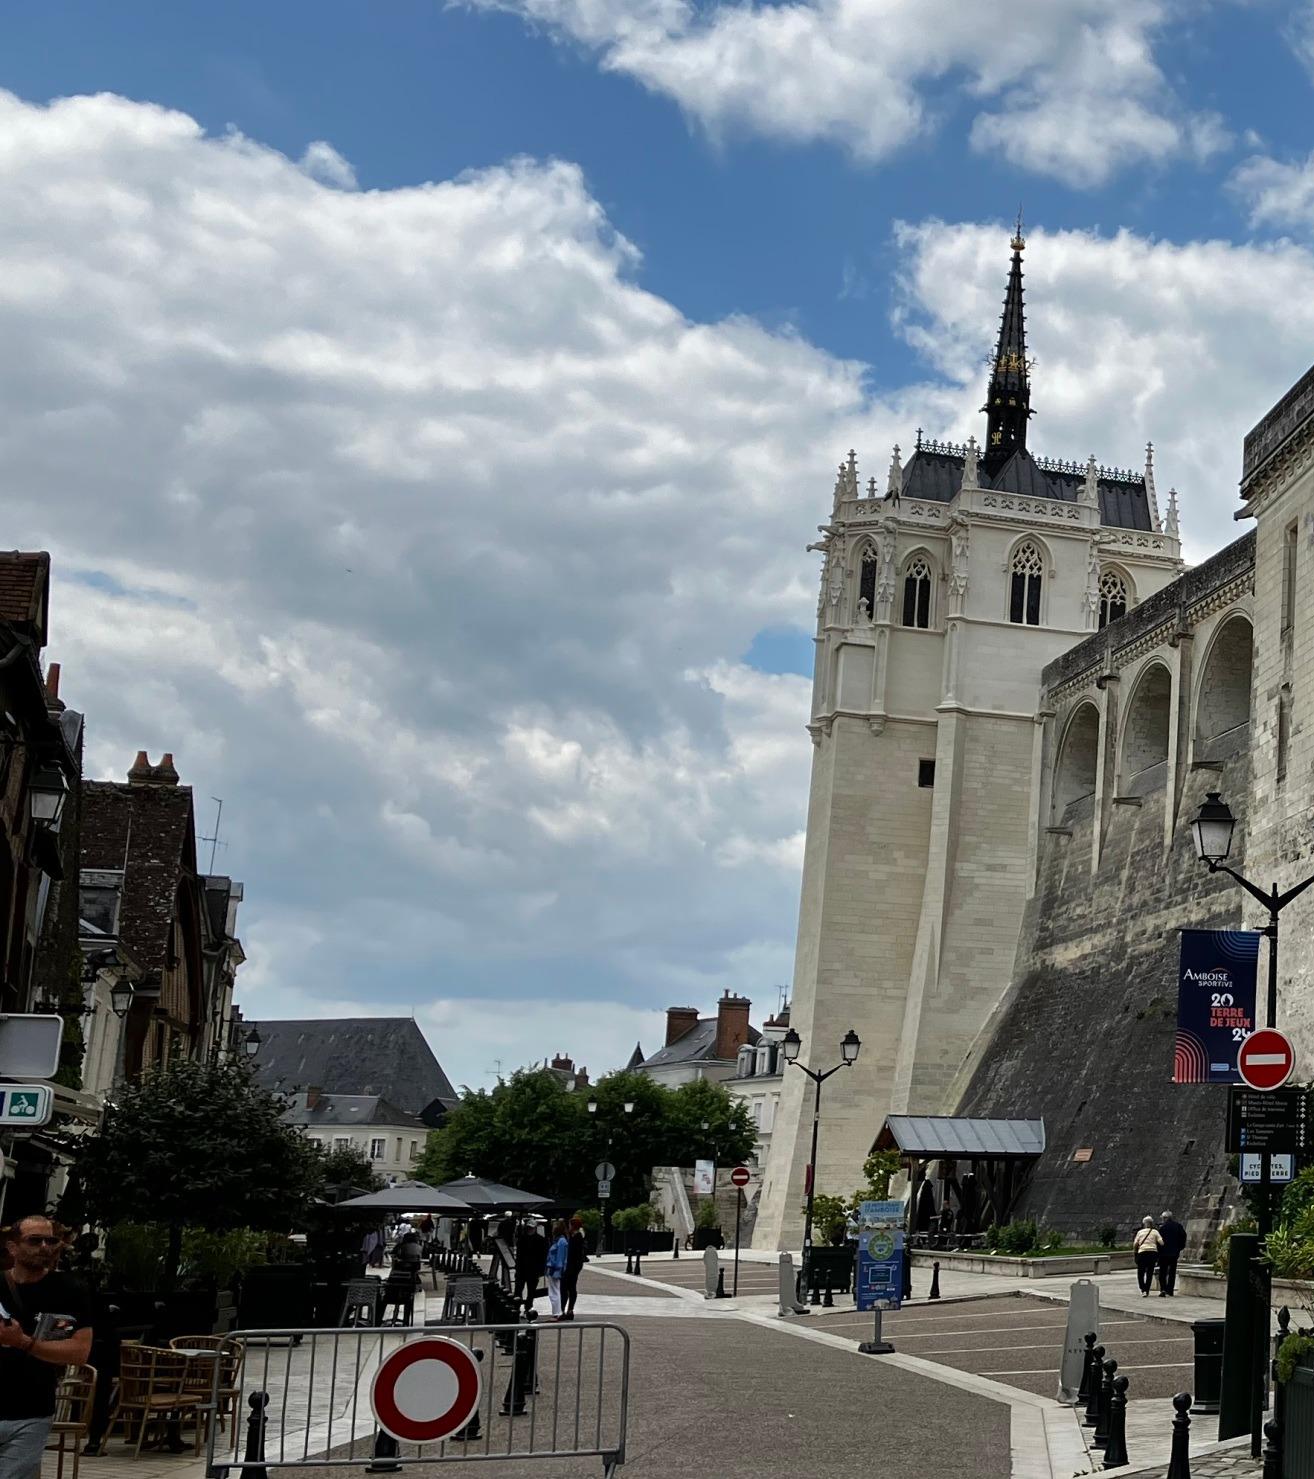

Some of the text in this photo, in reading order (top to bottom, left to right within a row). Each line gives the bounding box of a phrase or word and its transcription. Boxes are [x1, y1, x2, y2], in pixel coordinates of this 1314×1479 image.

[1198, 980, 1233, 988] SPORTIVE
[1211, 993, 1234, 1007] 20
[1210, 1007, 1244, 1018] TERRE
[1210, 1017, 1251, 1028] DE JEUX
